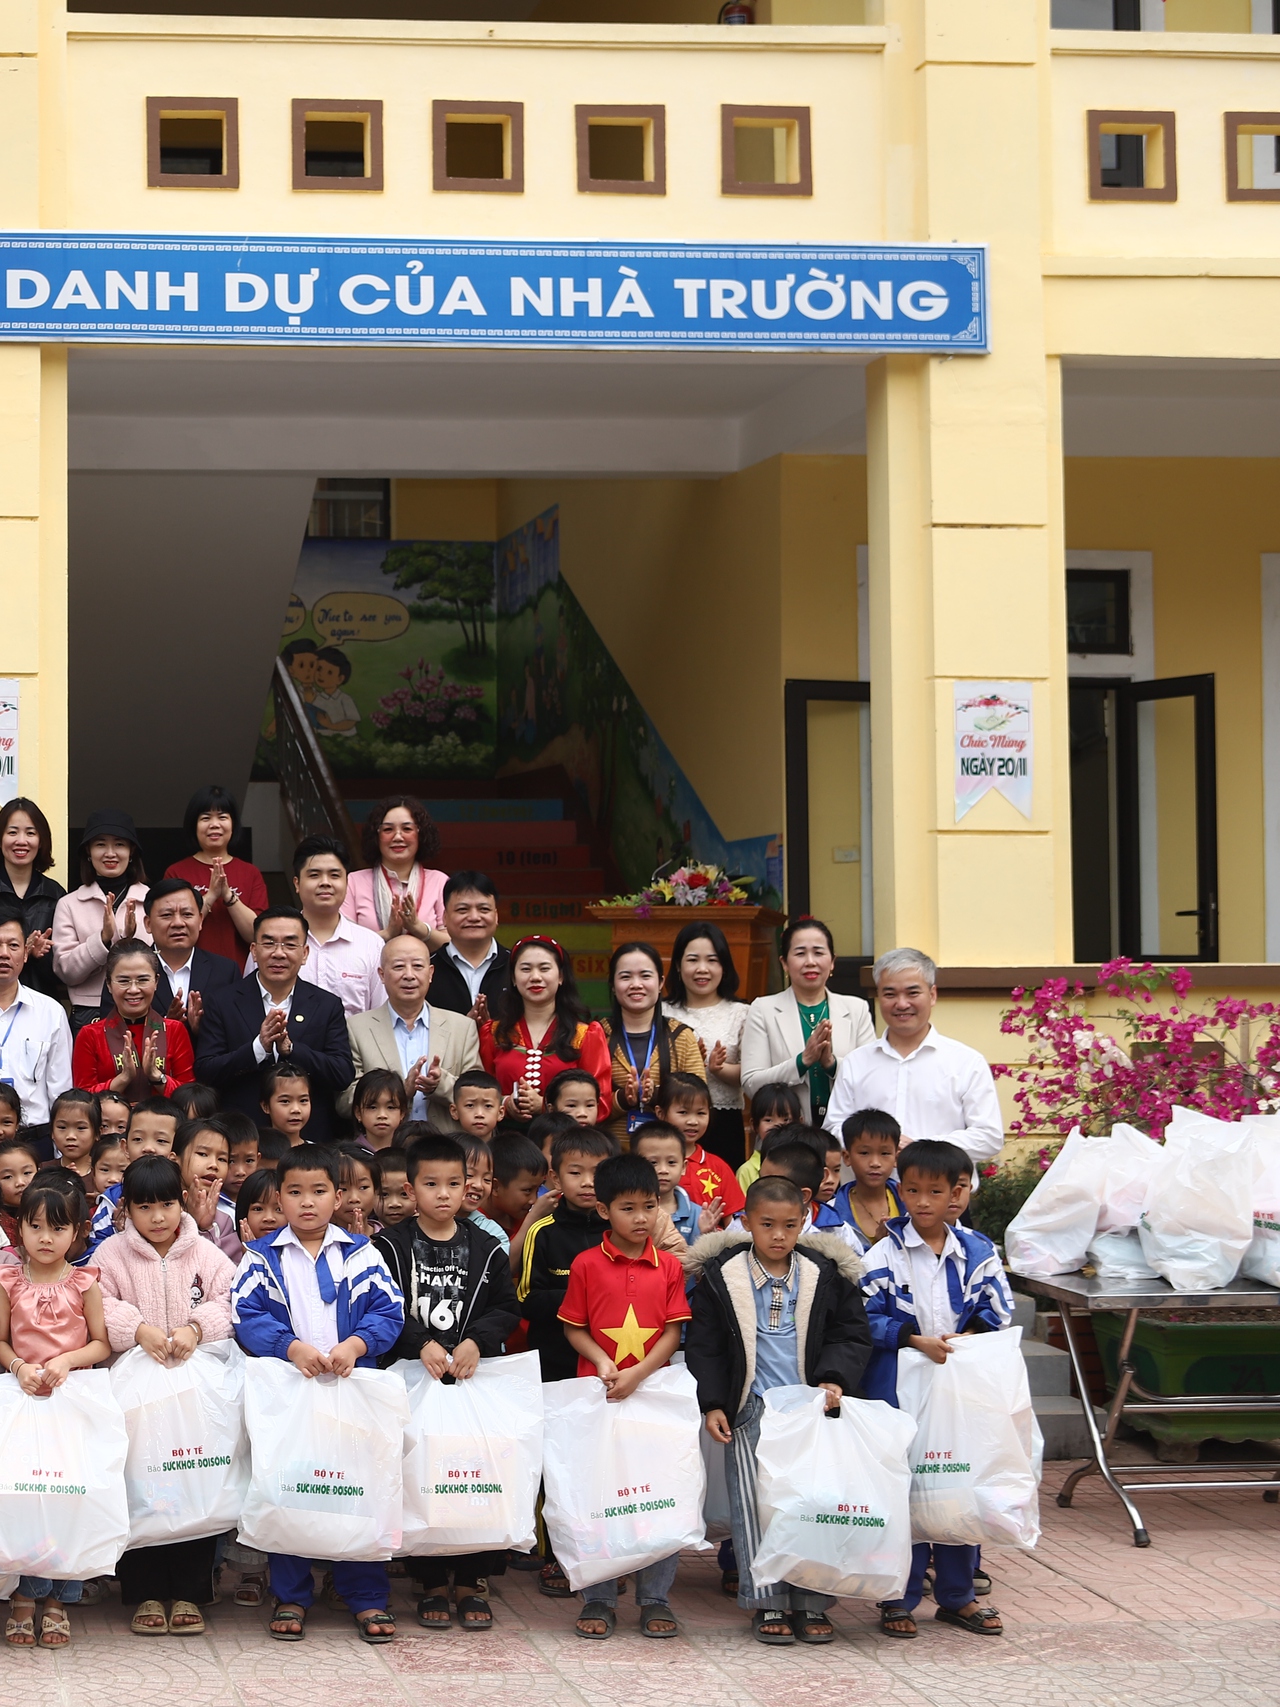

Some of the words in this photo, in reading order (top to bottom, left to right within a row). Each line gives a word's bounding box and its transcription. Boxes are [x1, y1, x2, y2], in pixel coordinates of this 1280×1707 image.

[7, 270, 198, 312] DANH
[226, 268, 319, 325] DỰ
[339, 260, 487, 315] CỦA
[511, 266, 654, 317] NHÀ
[674, 267, 948, 320] TRƯỜNG
[384, 614, 402, 625] you
[960, 752, 995, 776] NGÀY
[997, 757, 1028, 778] 20/11
[496, 851, 516, 865] 10
[520, 851, 558, 866] (ten)
[172, 1447, 184, 1458] BỘ
[314, 1469, 326, 1479] BỘ
[448, 1469, 460, 1479] BỘ
[617, 1487, 630, 1498] BỘ
[838, 1503, 849, 1513] BỘ
